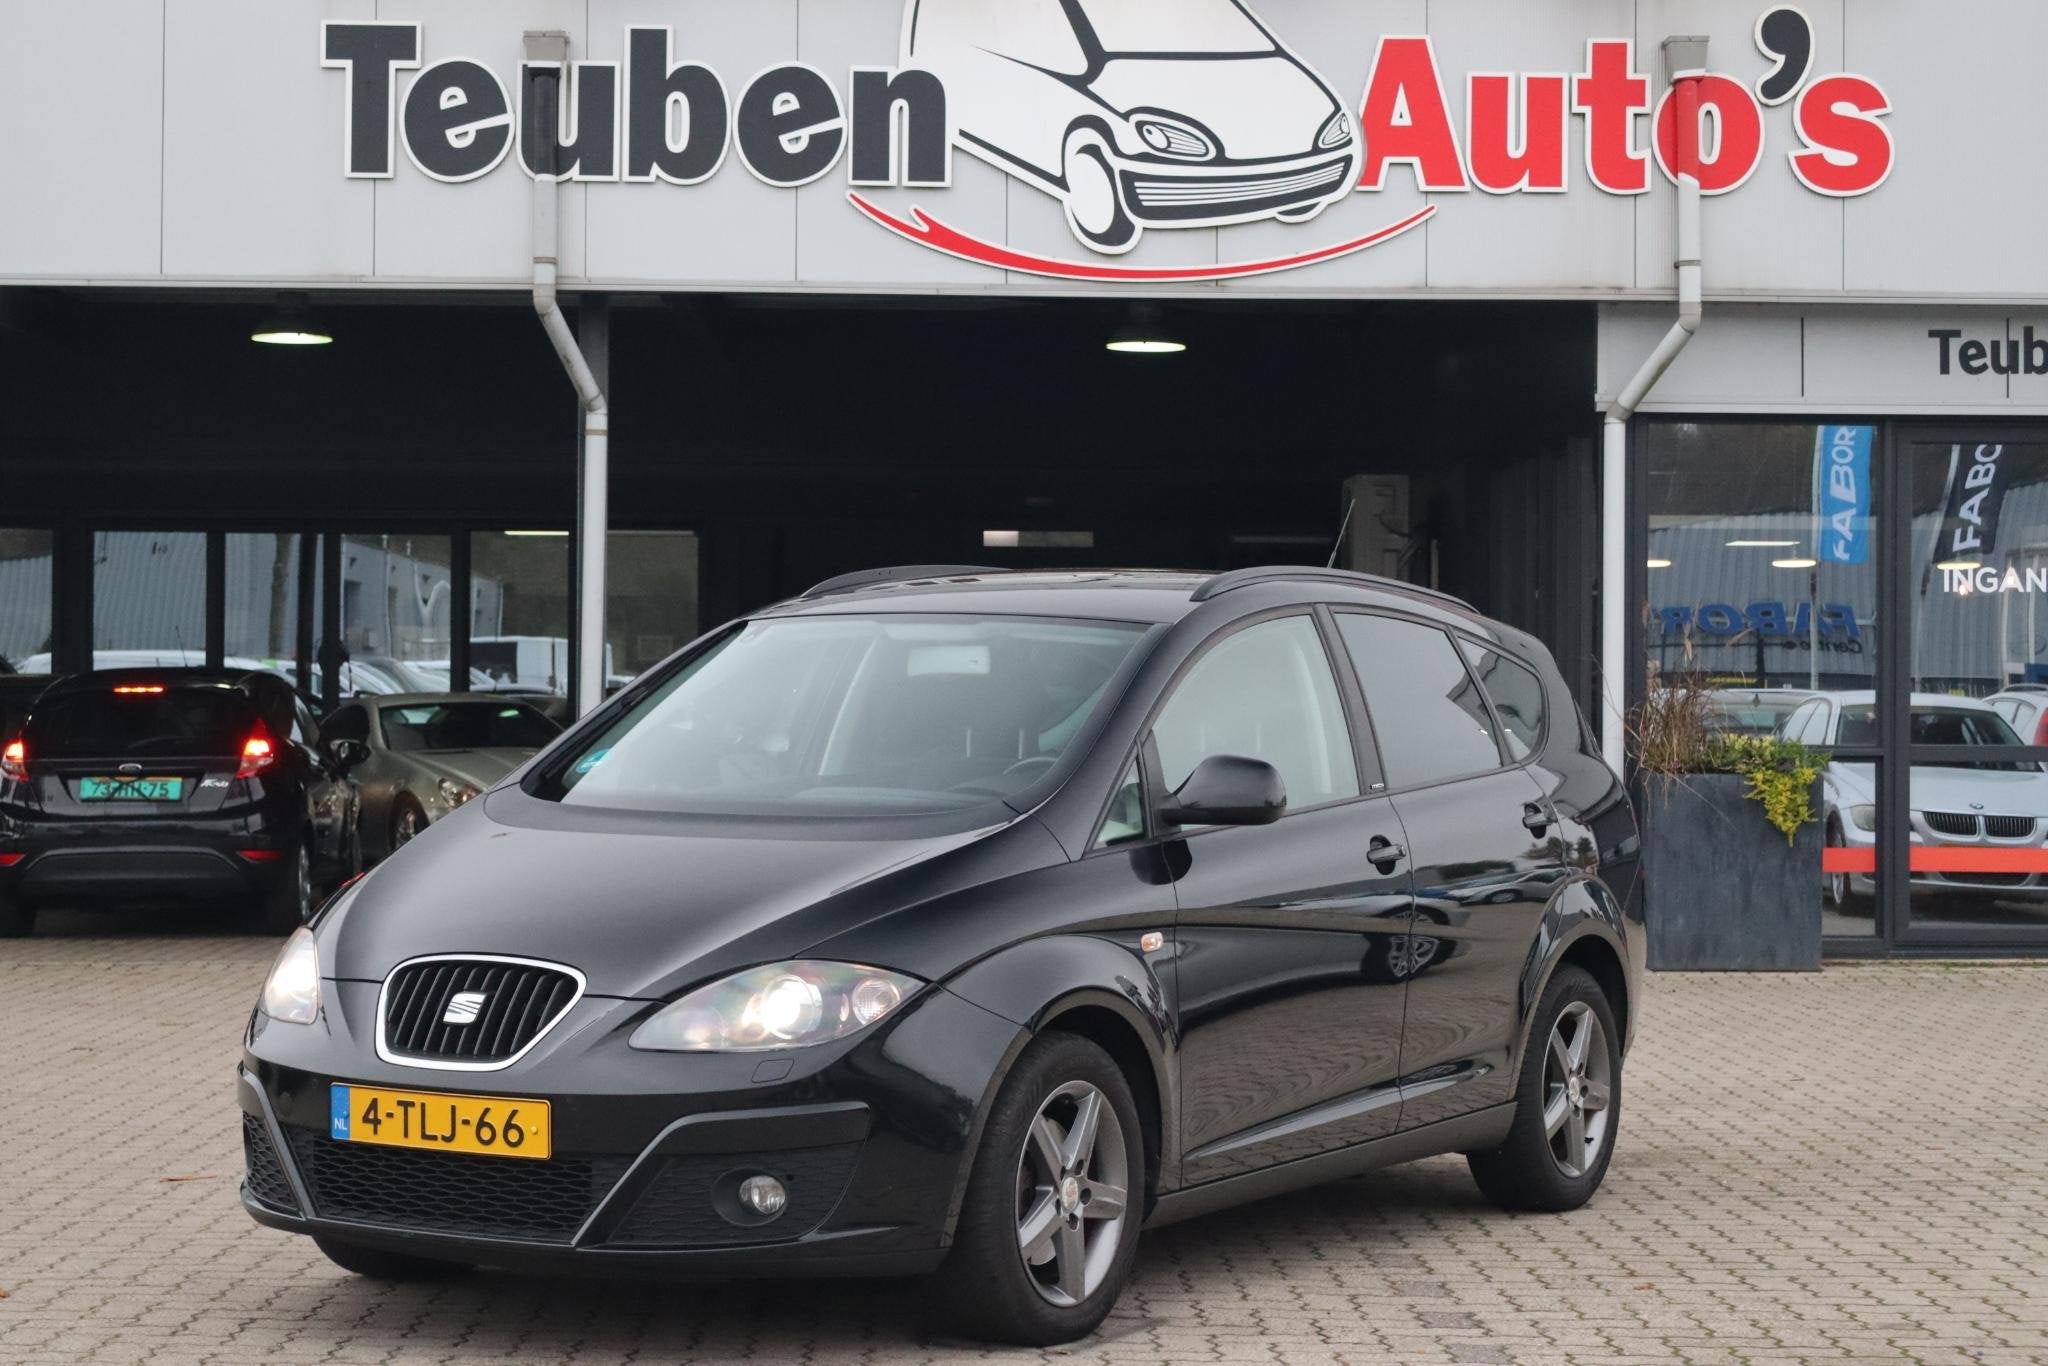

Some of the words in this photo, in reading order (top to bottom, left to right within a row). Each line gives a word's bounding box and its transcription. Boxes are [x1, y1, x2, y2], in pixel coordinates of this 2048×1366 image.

[323, 22, 949, 185] Teuben
[1357, 6, 1894, 195] Auto's
[1928, 325, 2048, 375] Teub
[1943, 566, 2048, 593] INGAN
[334, 1117, 348, 1131] NL
[361, 1097, 525, 1148] 4-TLJ-66
